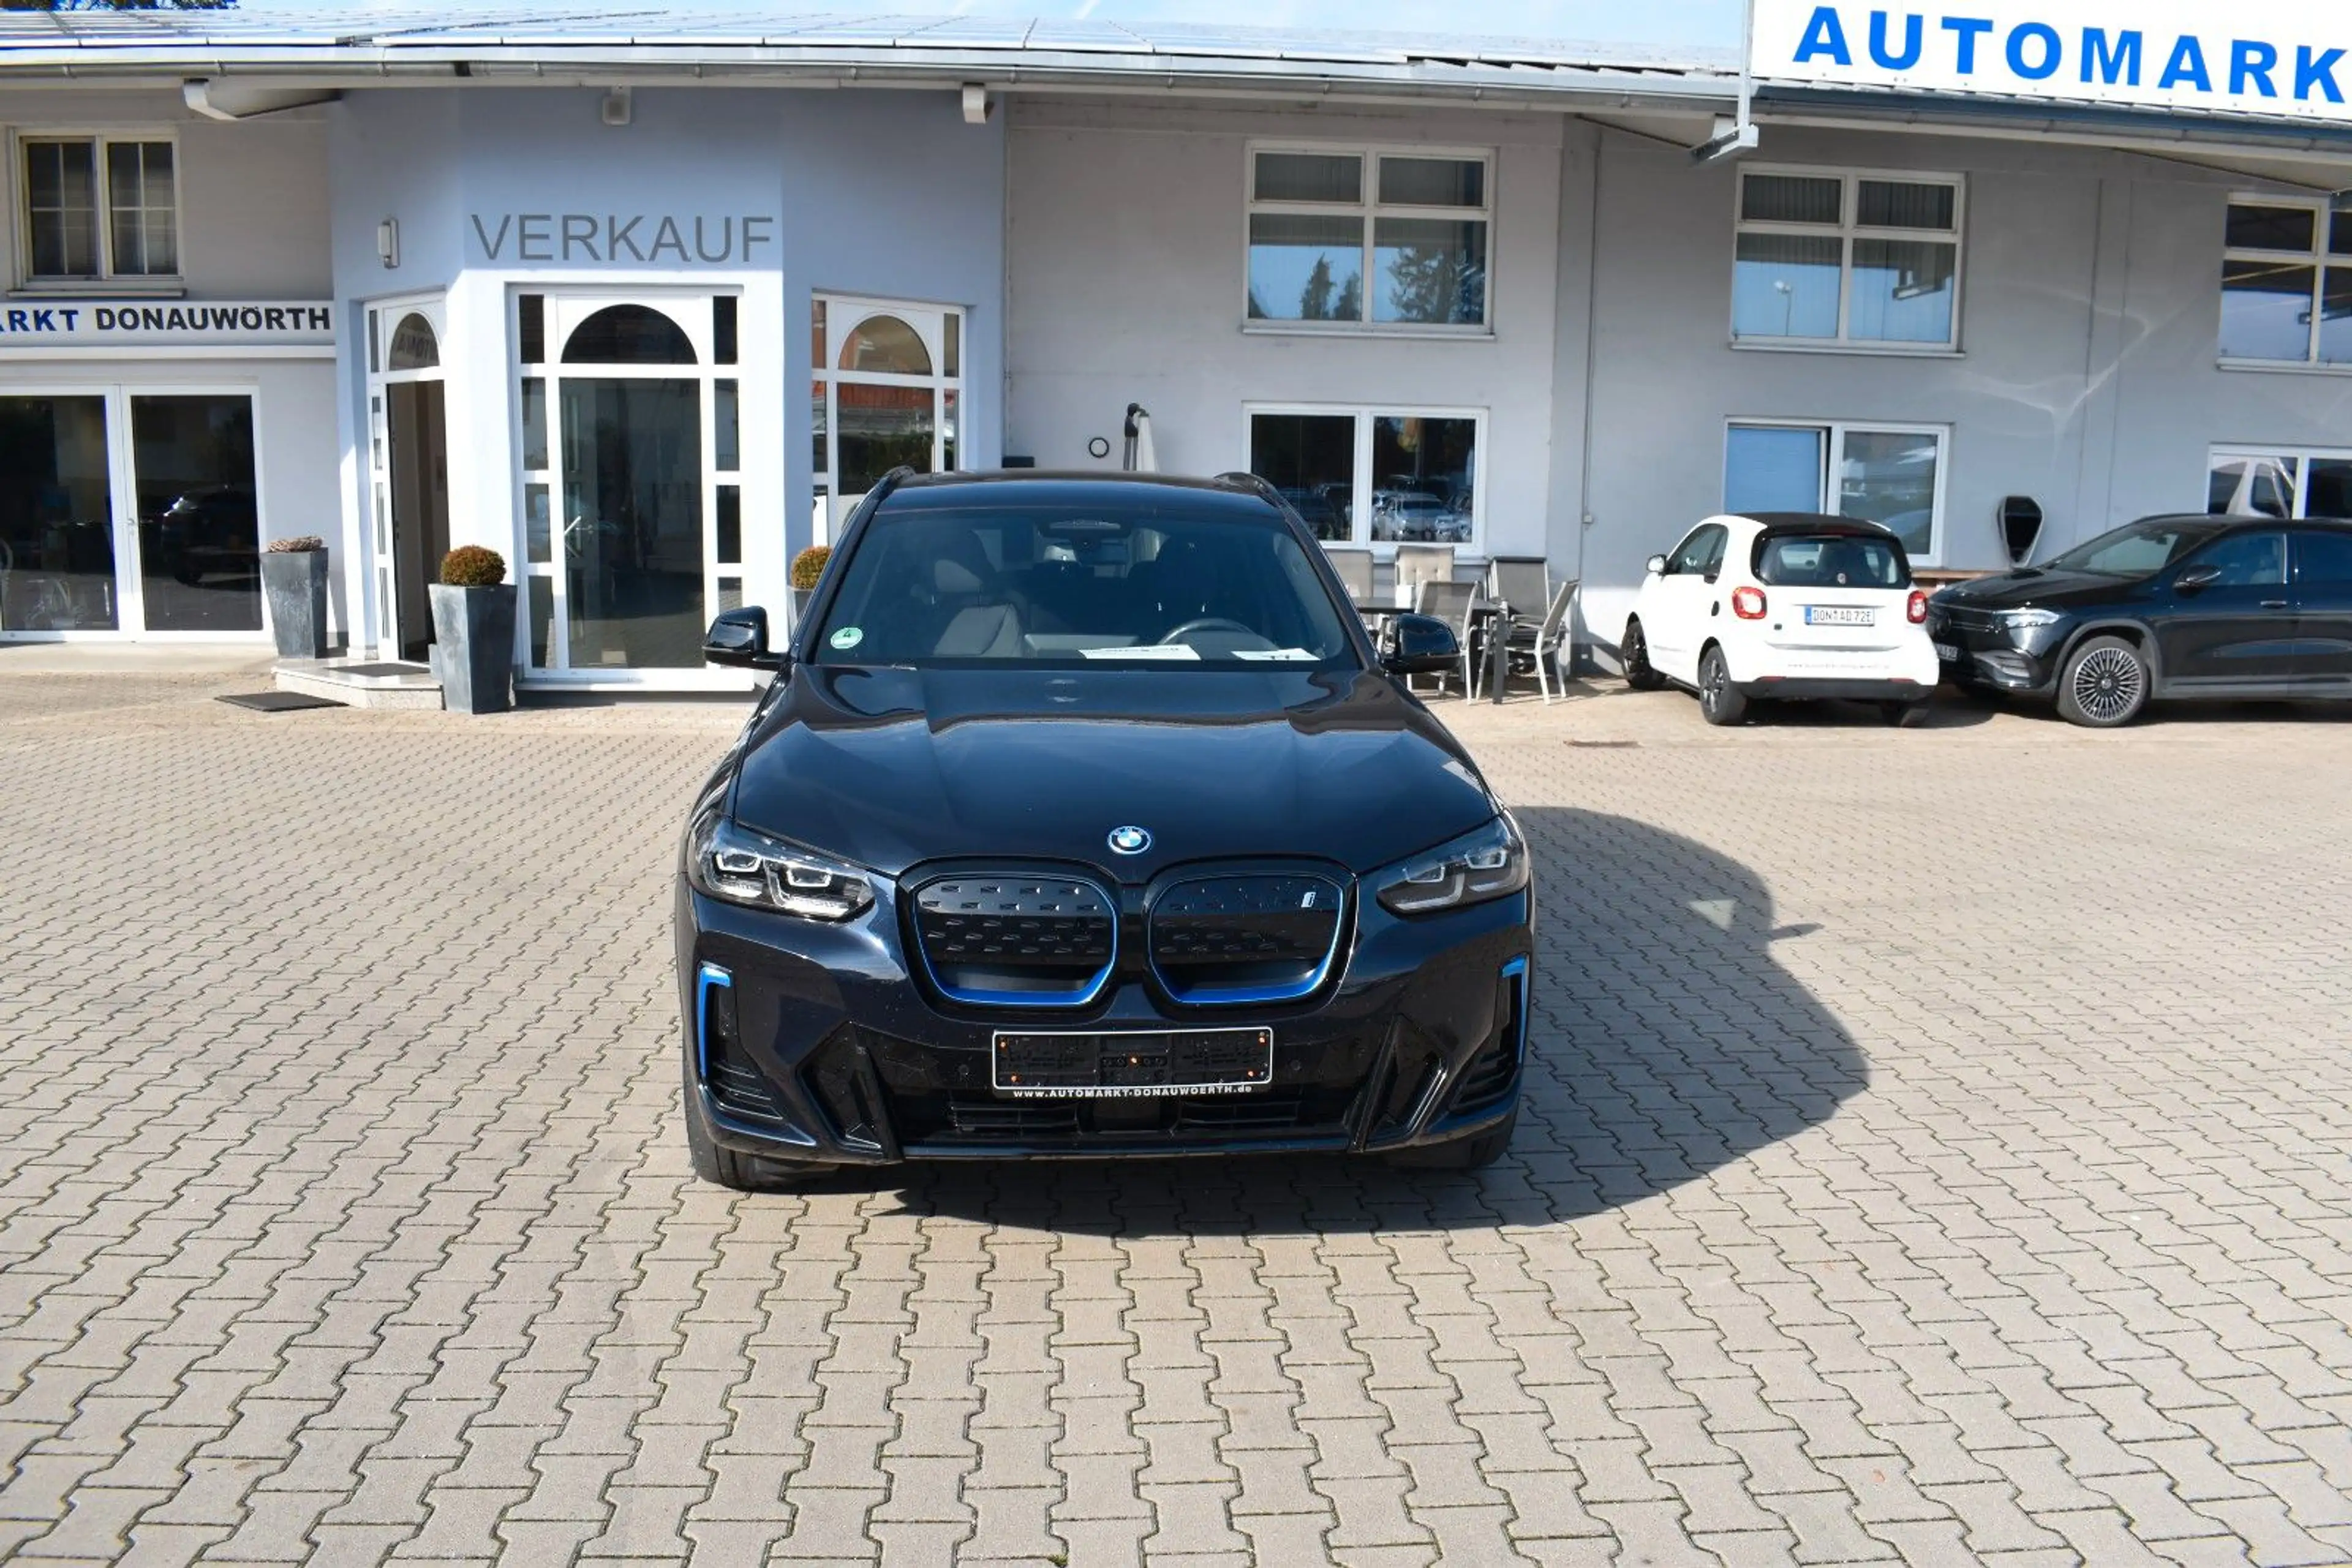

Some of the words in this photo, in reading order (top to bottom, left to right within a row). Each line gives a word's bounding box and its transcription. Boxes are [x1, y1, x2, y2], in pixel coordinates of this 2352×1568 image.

[1792, 6, 2348, 103] AUTOMARK
[471, 214, 774, 262] VERKAUF
[0, 309, 79, 331] RKT
[95, 306, 331, 330] DONAUWÖRTH
